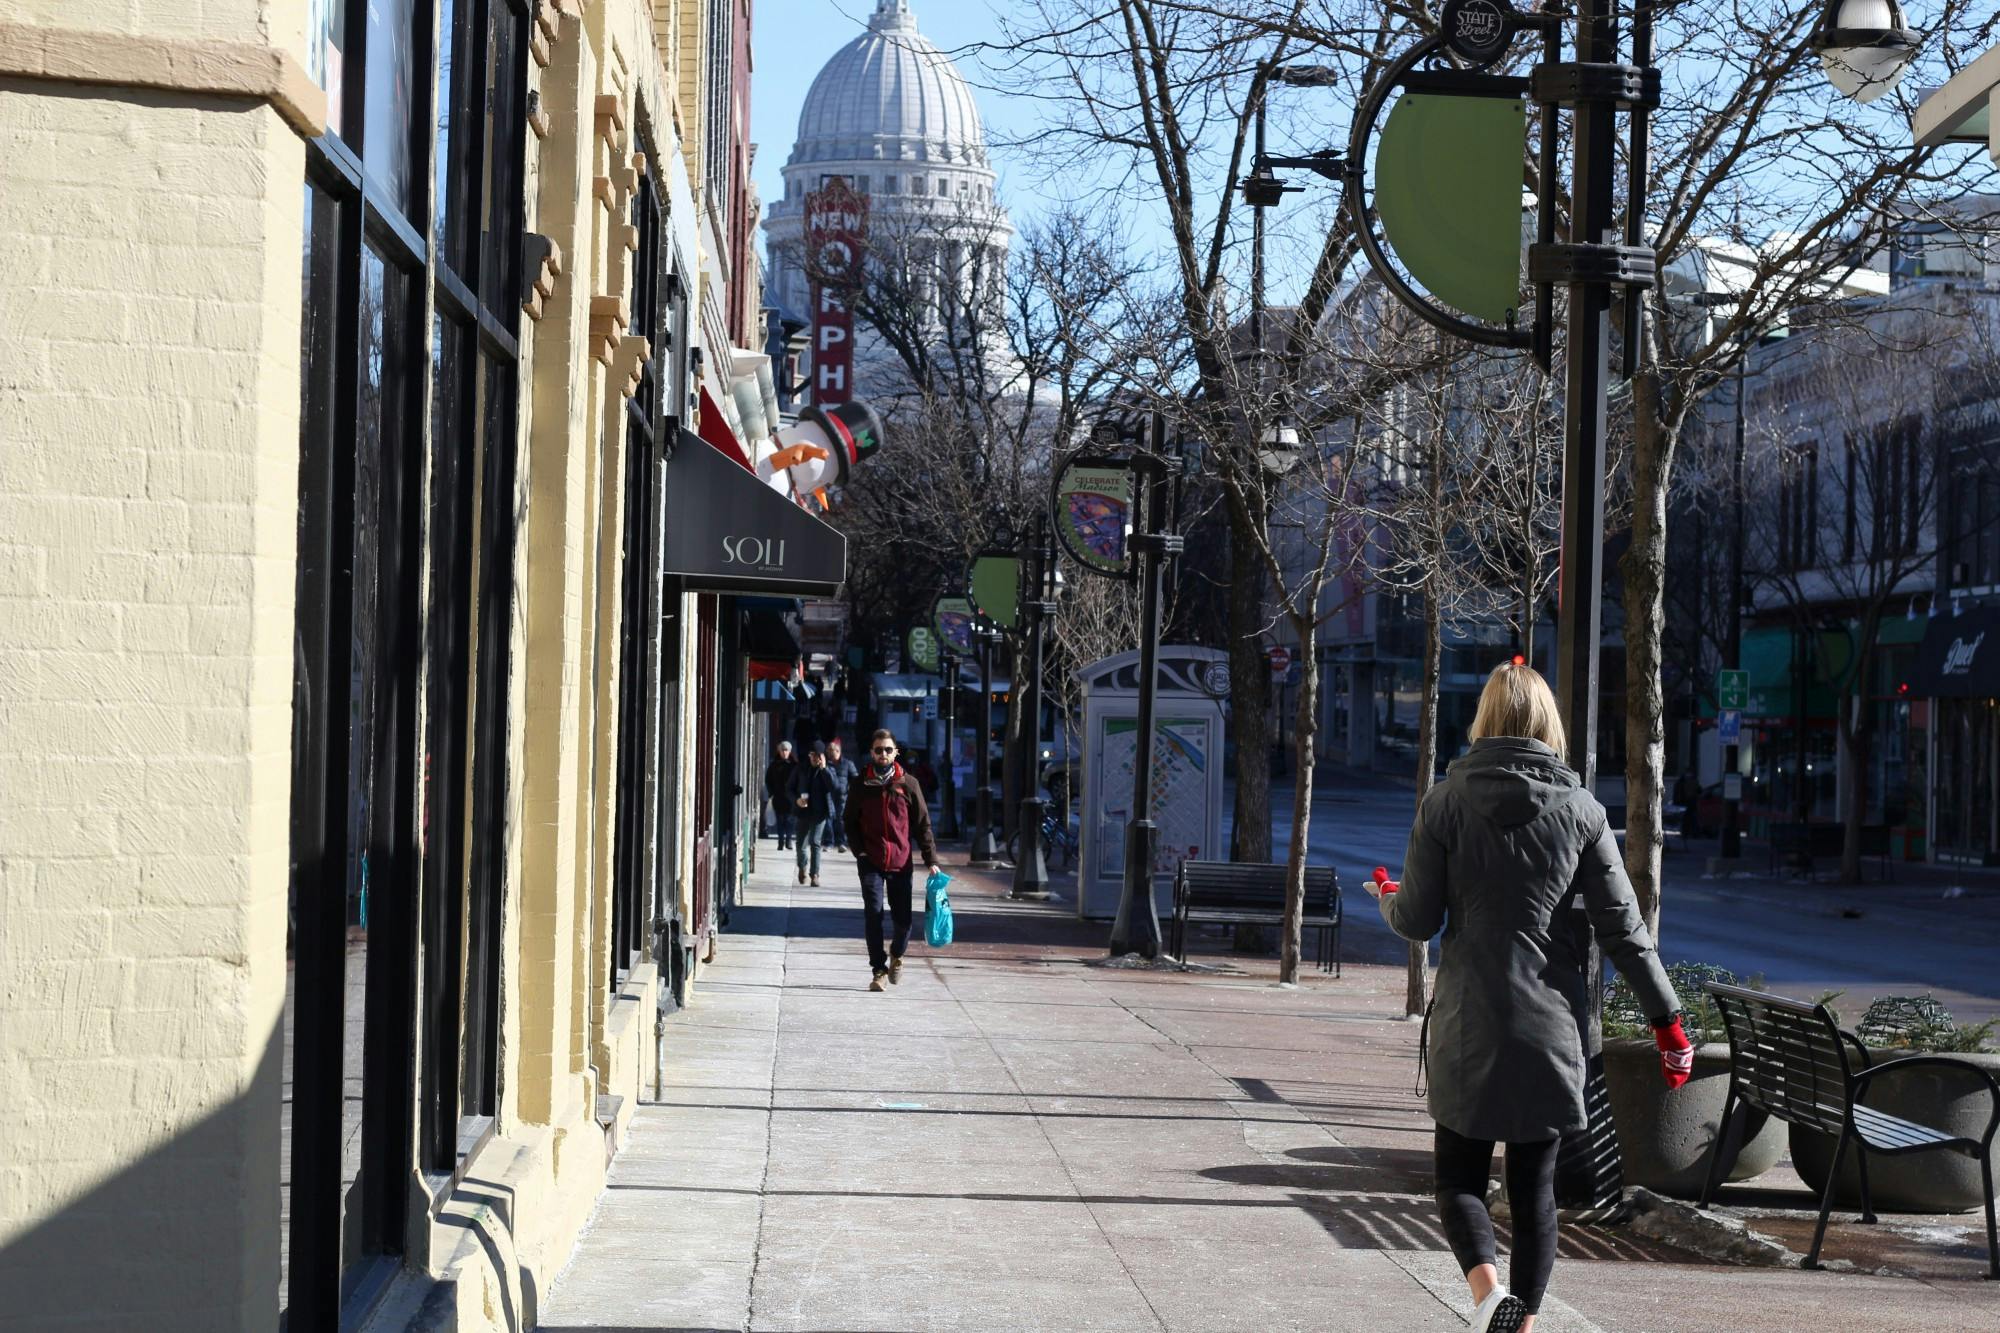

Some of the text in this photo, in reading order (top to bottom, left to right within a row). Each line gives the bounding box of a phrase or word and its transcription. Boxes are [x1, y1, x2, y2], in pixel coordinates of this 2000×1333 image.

[1456, 9, 1497, 27] STATE
[1456, 24, 1491, 37] Street
[810, 211, 862, 232] NEW
[1072, 481, 1119, 492] Madison
[1074, 476, 1120, 485] CELEBRATE
[721, 535, 785, 566] SOLI
[912, 627, 928, 664] 300
